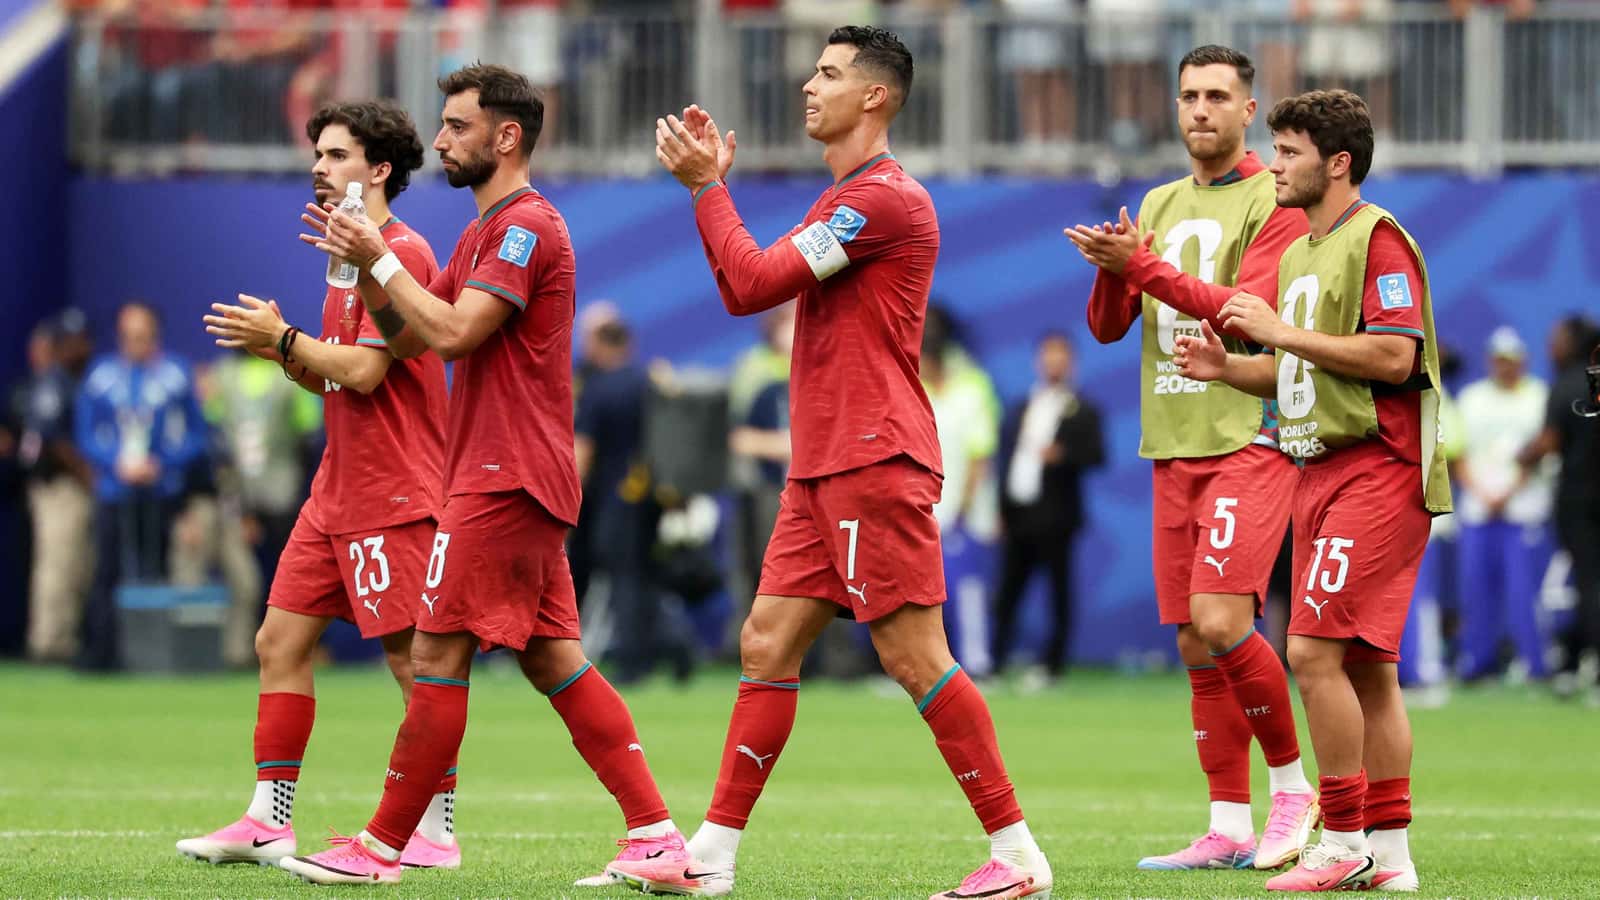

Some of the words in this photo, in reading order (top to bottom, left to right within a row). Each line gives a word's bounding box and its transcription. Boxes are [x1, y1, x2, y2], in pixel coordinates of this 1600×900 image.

[1156, 360, 1178, 373] WOR
[839, 519, 860, 580] 7
[1210, 497, 1238, 549] 5
[349, 534, 391, 598] 23
[425, 531, 451, 589] 8
[1306, 537, 1354, 593] 15
